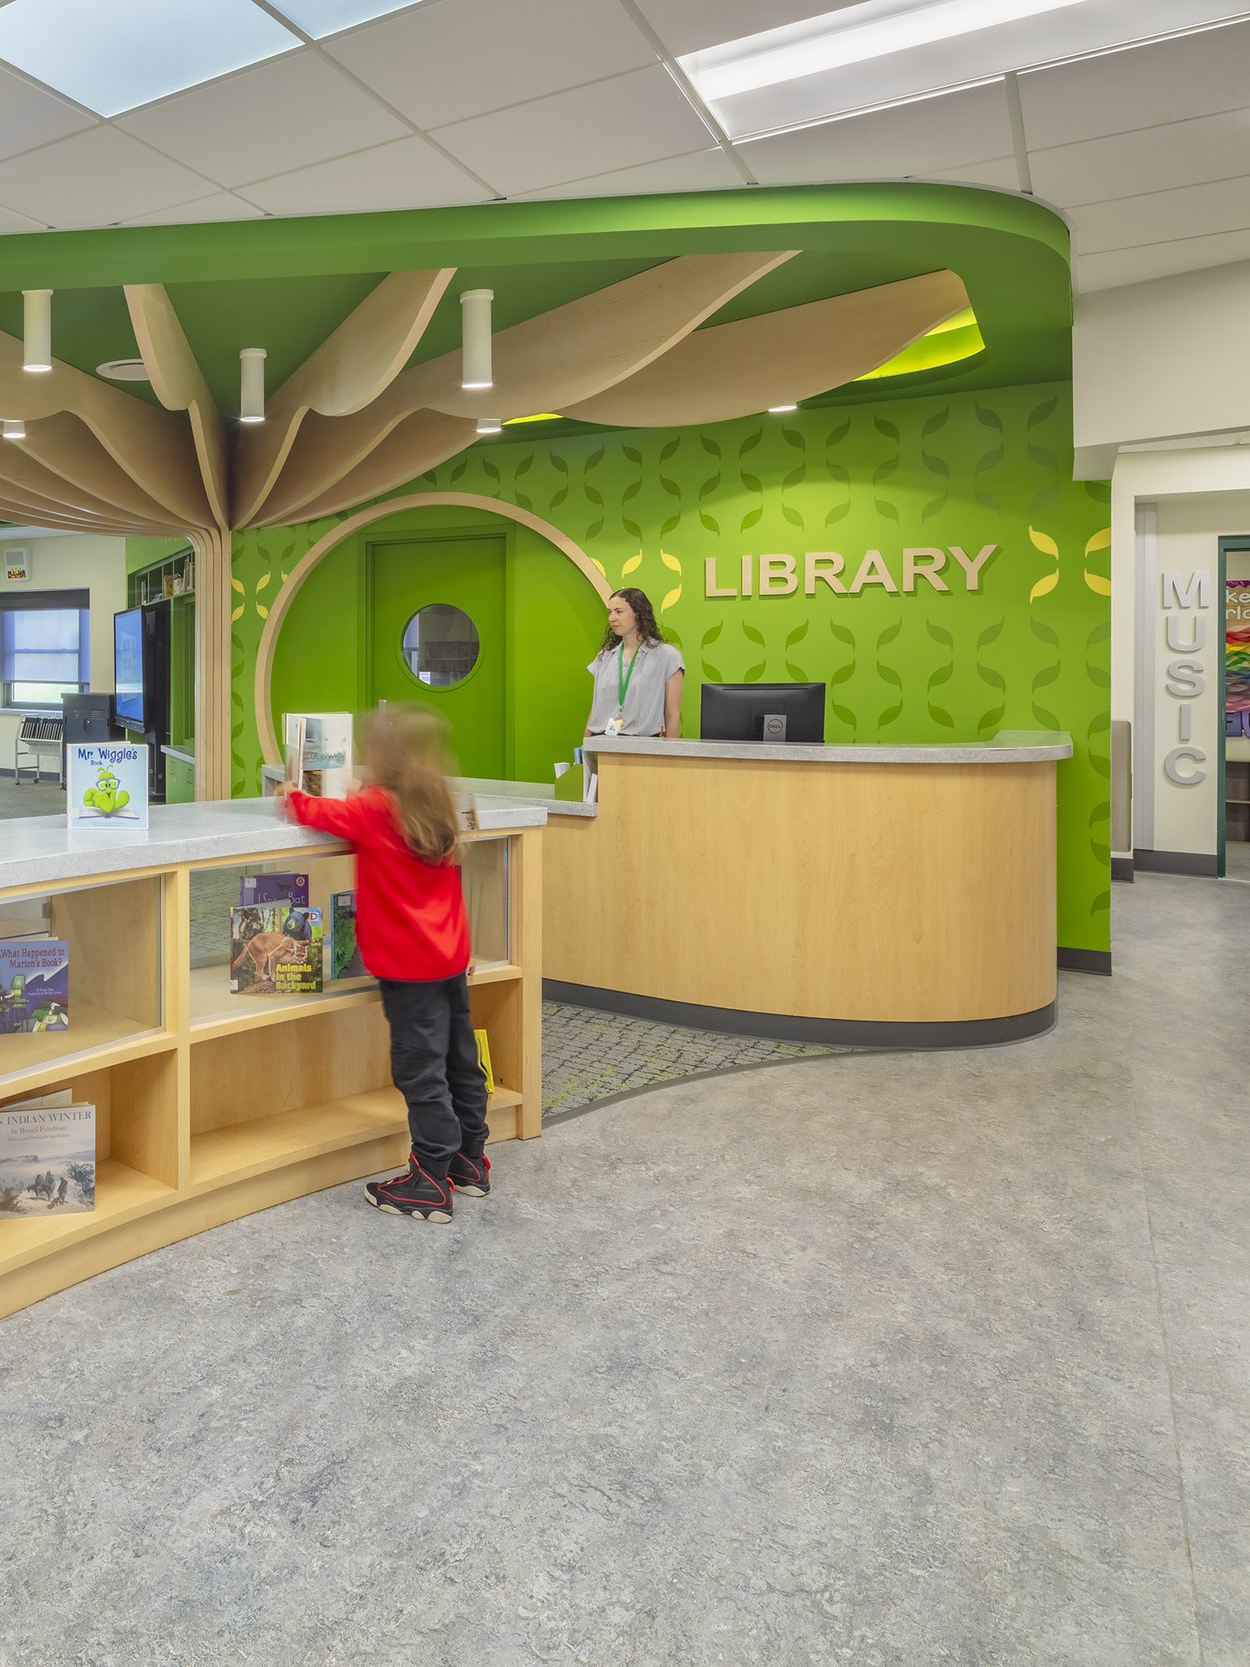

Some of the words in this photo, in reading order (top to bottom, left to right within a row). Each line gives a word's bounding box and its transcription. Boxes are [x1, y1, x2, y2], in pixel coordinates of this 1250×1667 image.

[705, 544, 999, 598] LIBRARY
[1161, 570, 1211, 788] MUSIC
[98, 747, 138, 764] Wiggle's
[0, 949, 21, 958] What
[22, 948, 56, 960] Happened
[57, 948, 65, 956] to
[9, 959, 40, 969] Marion's
[42, 958, 63, 967] Book?
[275, 963, 312, 973] Animals
[287, 973, 302, 981] the
[275, 981, 317, 991] Backyard
[7, 1115, 46, 1125] INDIAN
[48, 1111, 92, 1121] WINTER
